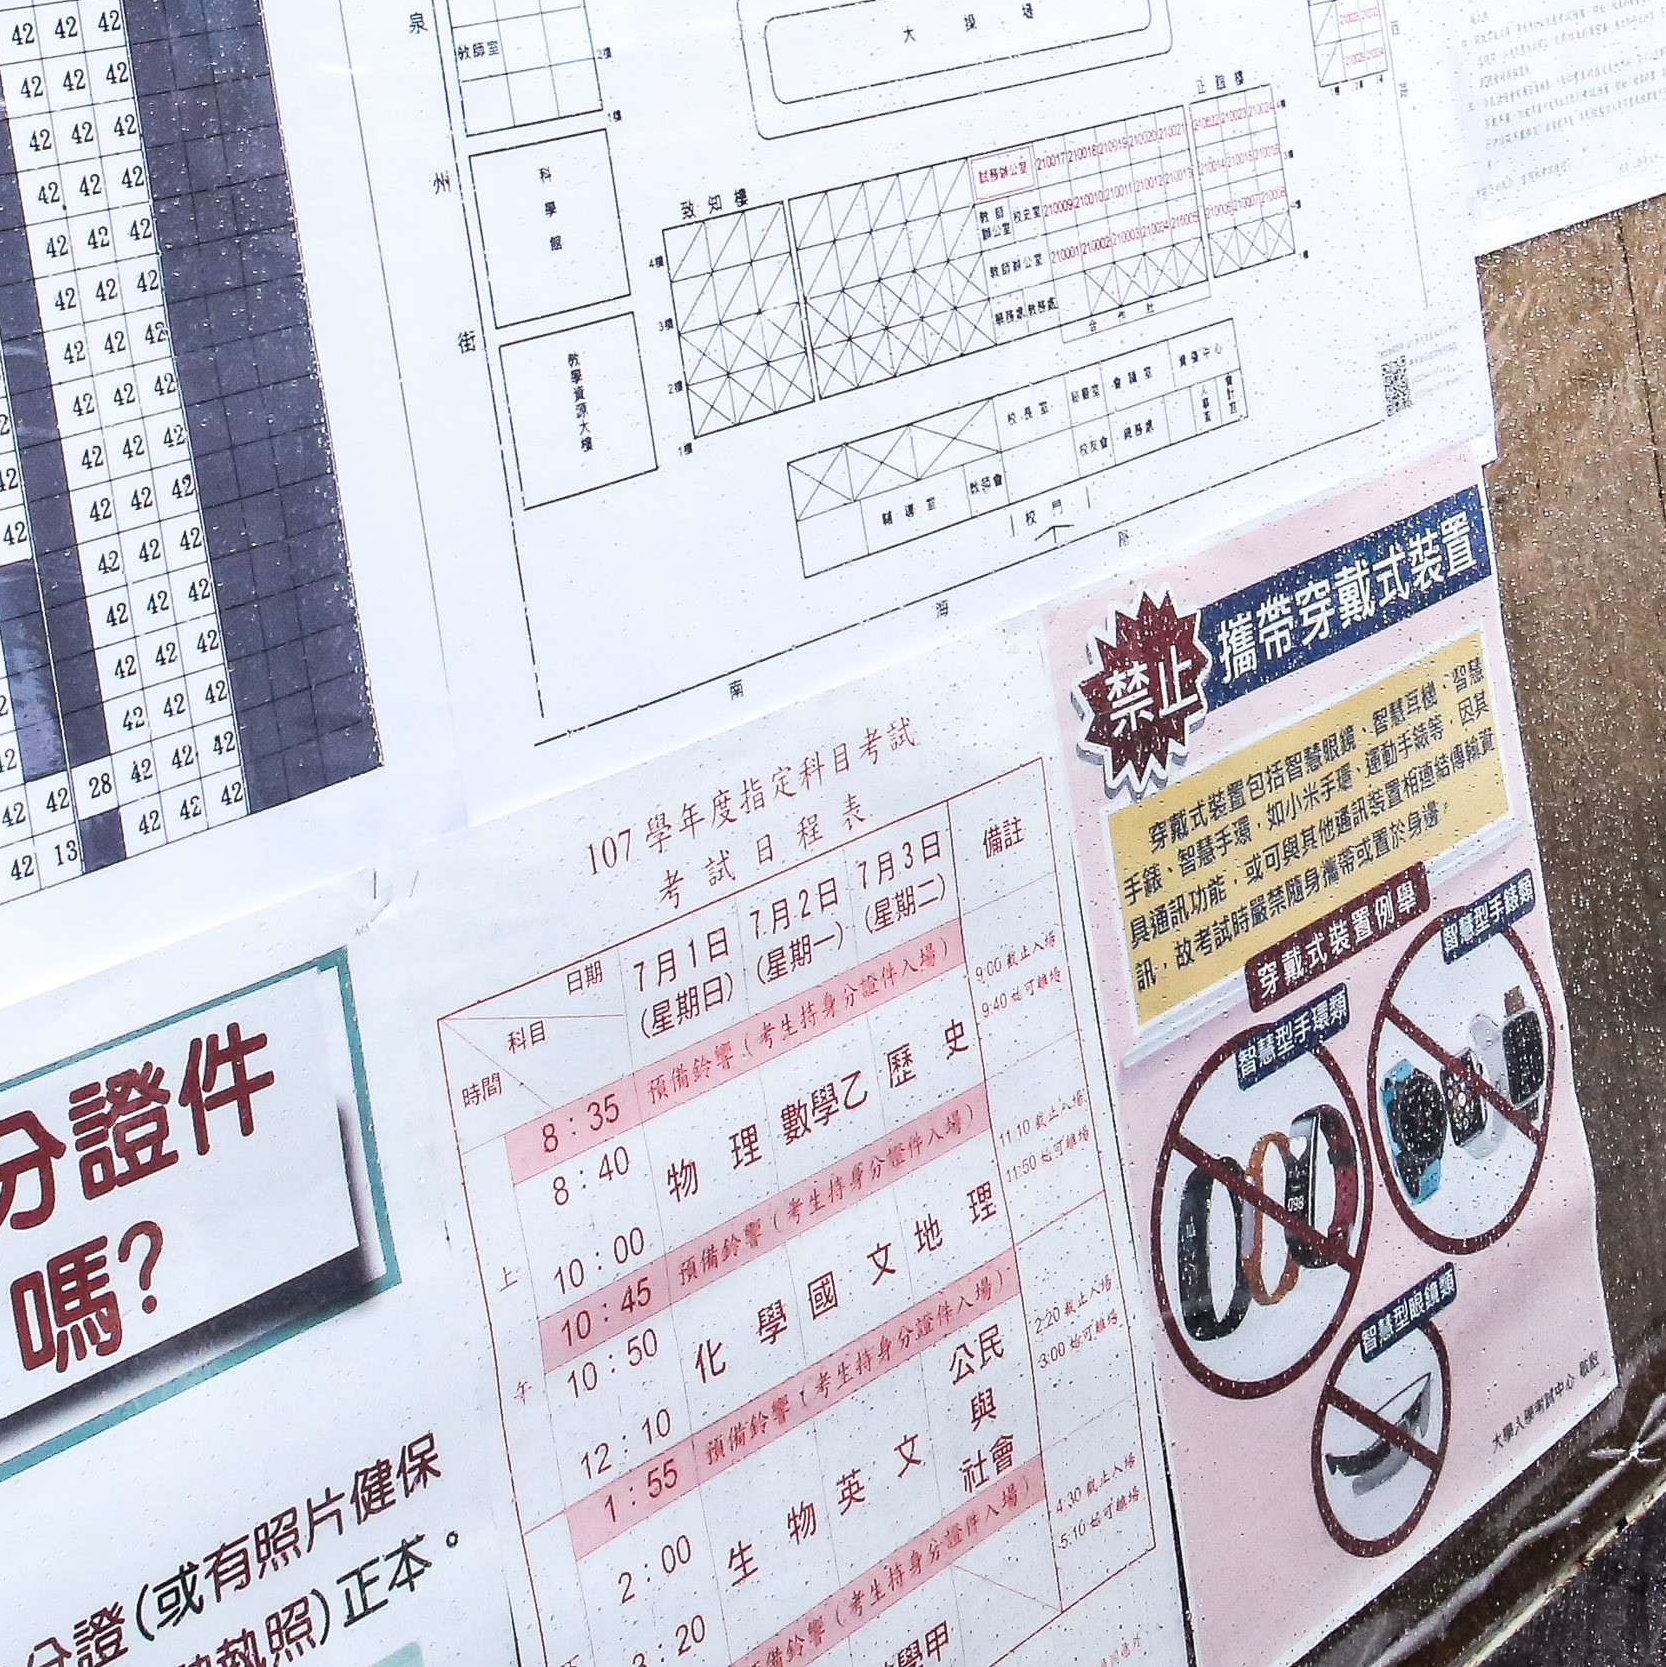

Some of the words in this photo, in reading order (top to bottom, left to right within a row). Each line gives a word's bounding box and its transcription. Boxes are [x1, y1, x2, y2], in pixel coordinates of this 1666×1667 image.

[1217, 508, 1478, 685] 攜帶穿戴式裝置
[1104, 643, 1201, 739] 禁止
[659, 790, 868, 911] 考試日程表
[856, 832, 942, 891] 7月3日
[982, 817, 1025, 858] 備註
[750, 877, 839, 941] 7月2日
[1256, 874, 1420, 1000] 穿戴式裝置例舉
[567, 962, 604, 998] 日期
[633, 926, 730, 990] 7月1日
[506, 1018, 548, 1054] 科目
[1237, 988, 1347, 1076] 智慧型手環類
[461, 1072, 503, 1109] 時間
[780, 1069, 870, 1146] 數學乙
[1361, 1271, 1456, 1354] 智慧型眼鏡類
[948, 1323, 1005, 1387] 公民
[969, 1390, 999, 1431] 與
[959, 1435, 1017, 1494] 社會
